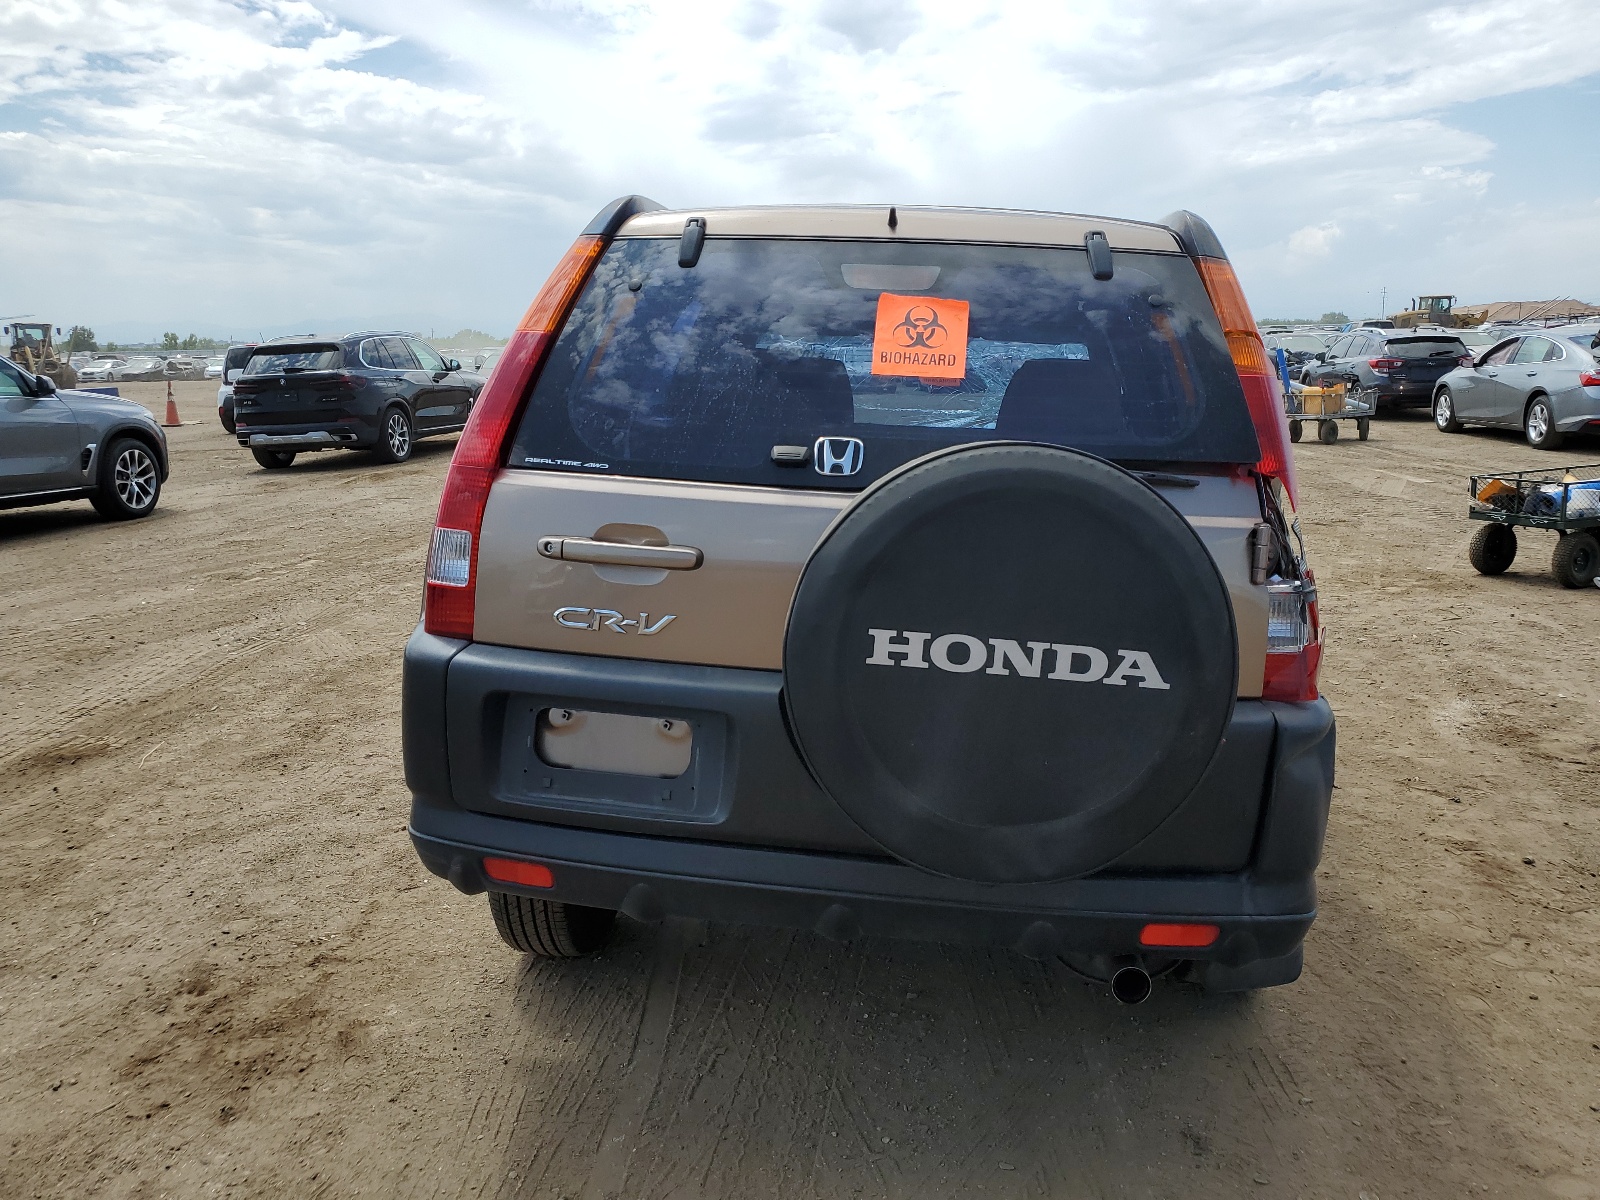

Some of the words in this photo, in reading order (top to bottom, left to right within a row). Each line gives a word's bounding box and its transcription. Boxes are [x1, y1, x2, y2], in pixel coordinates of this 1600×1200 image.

[880, 351, 956, 367] BIOHAZARD
[553, 606, 677, 635] CR-V
[865, 628, 1170, 690] HONDA
